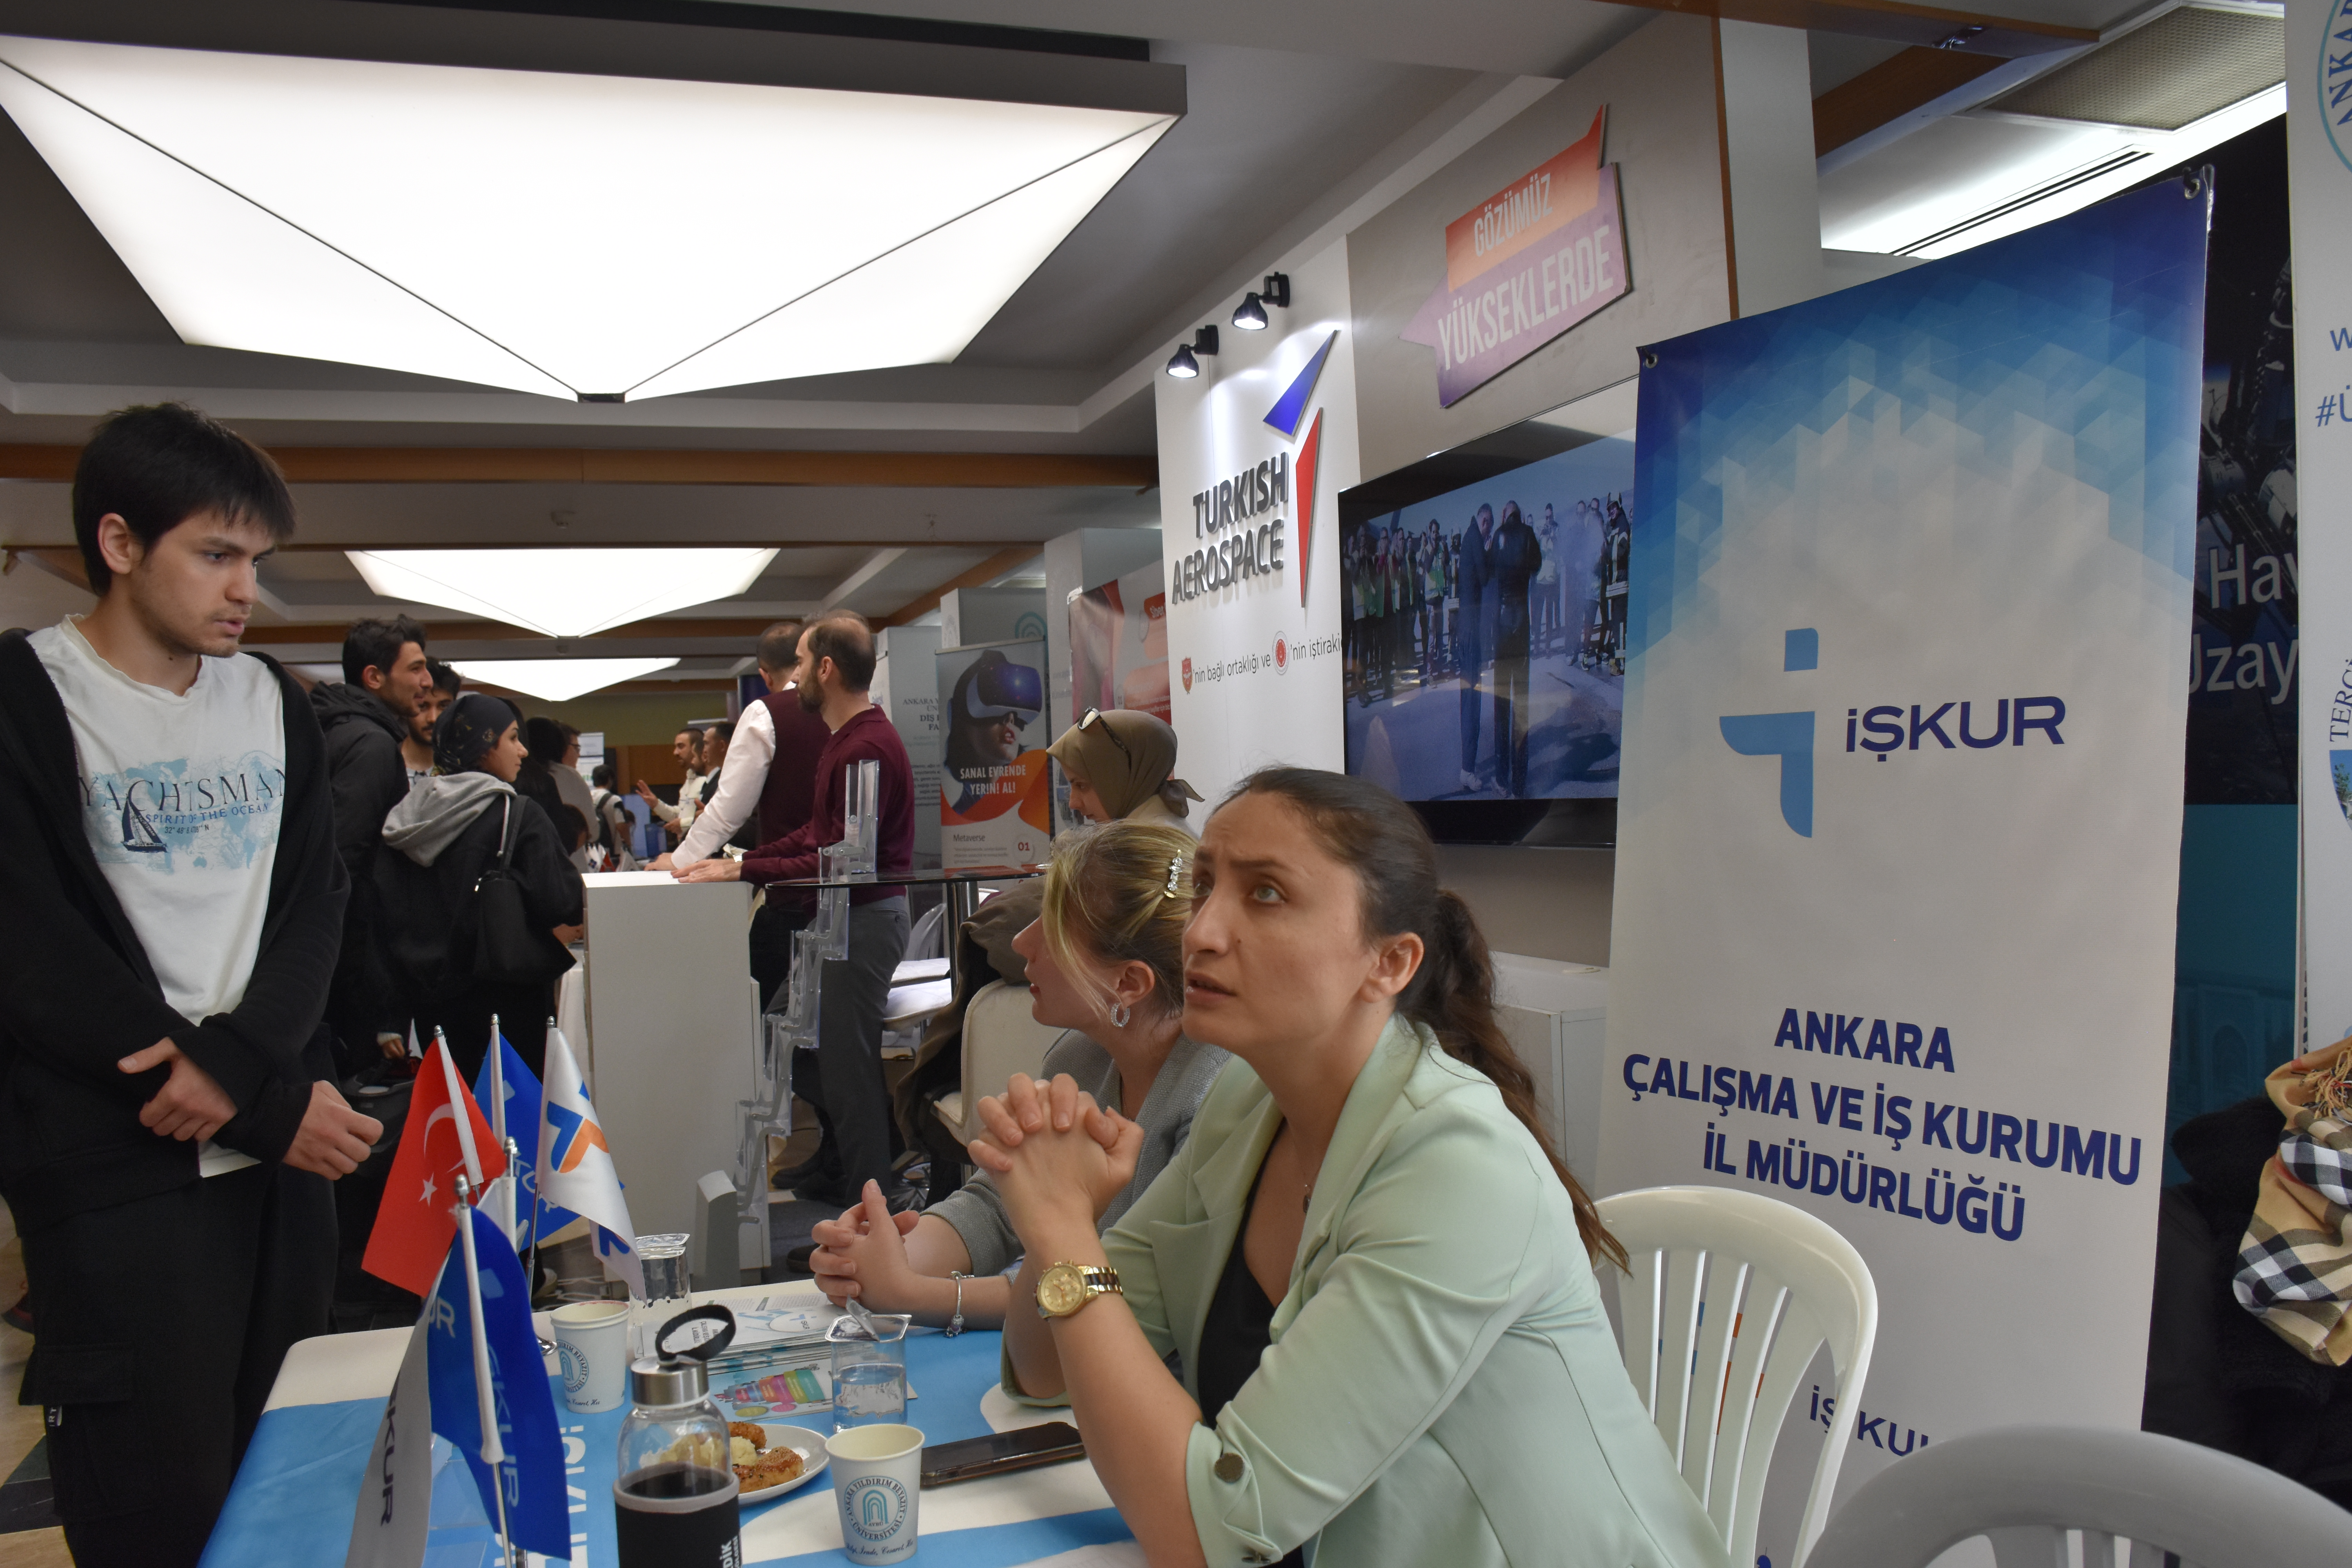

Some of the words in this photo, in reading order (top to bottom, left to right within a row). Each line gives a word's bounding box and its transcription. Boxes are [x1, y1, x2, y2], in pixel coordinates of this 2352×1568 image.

[1474, 173, 1553, 257] GÖZÜMÜZ
[1438, 225, 1613, 370] YÜKSEKLERDE
[1193, 452, 1289, 539] TURKISH
[1172, 519, 1284, 604] AEROSPACE
[1207, 661, 1225, 682] bağlı
[1227, 654, 1259, 675] ortaklığı
[1261, 654, 1271, 667] ve
[960, 767, 986, 779] SANAL
[988, 765, 1026, 777] EVRENDE
[1002, 782, 1016, 793] AL!
[146, 814, 186, 824] SPIRIT
[200, 808, 227, 822] THE
[231, 803, 269, 816] OCEAN
[1018, 842, 1030, 851] 01
[1774, 1008, 1955, 1073] ANKARA
[1623, 1054, 1798, 1117] ÇALIŞMA
[1810, 1082, 1864, 1131] VE
[1873, 1083, 1912, 1151] İŞ
[1923, 1101, 2141, 1185] KURUMU
[1703, 1122, 1736, 1175] İL
[1746, 1138, 2025, 1241] MÜDÜRLÜĞÜ
[853, 1479, 892, 1490] YILDIRIM
[892, 1483, 906, 1514] BEYAZIT
